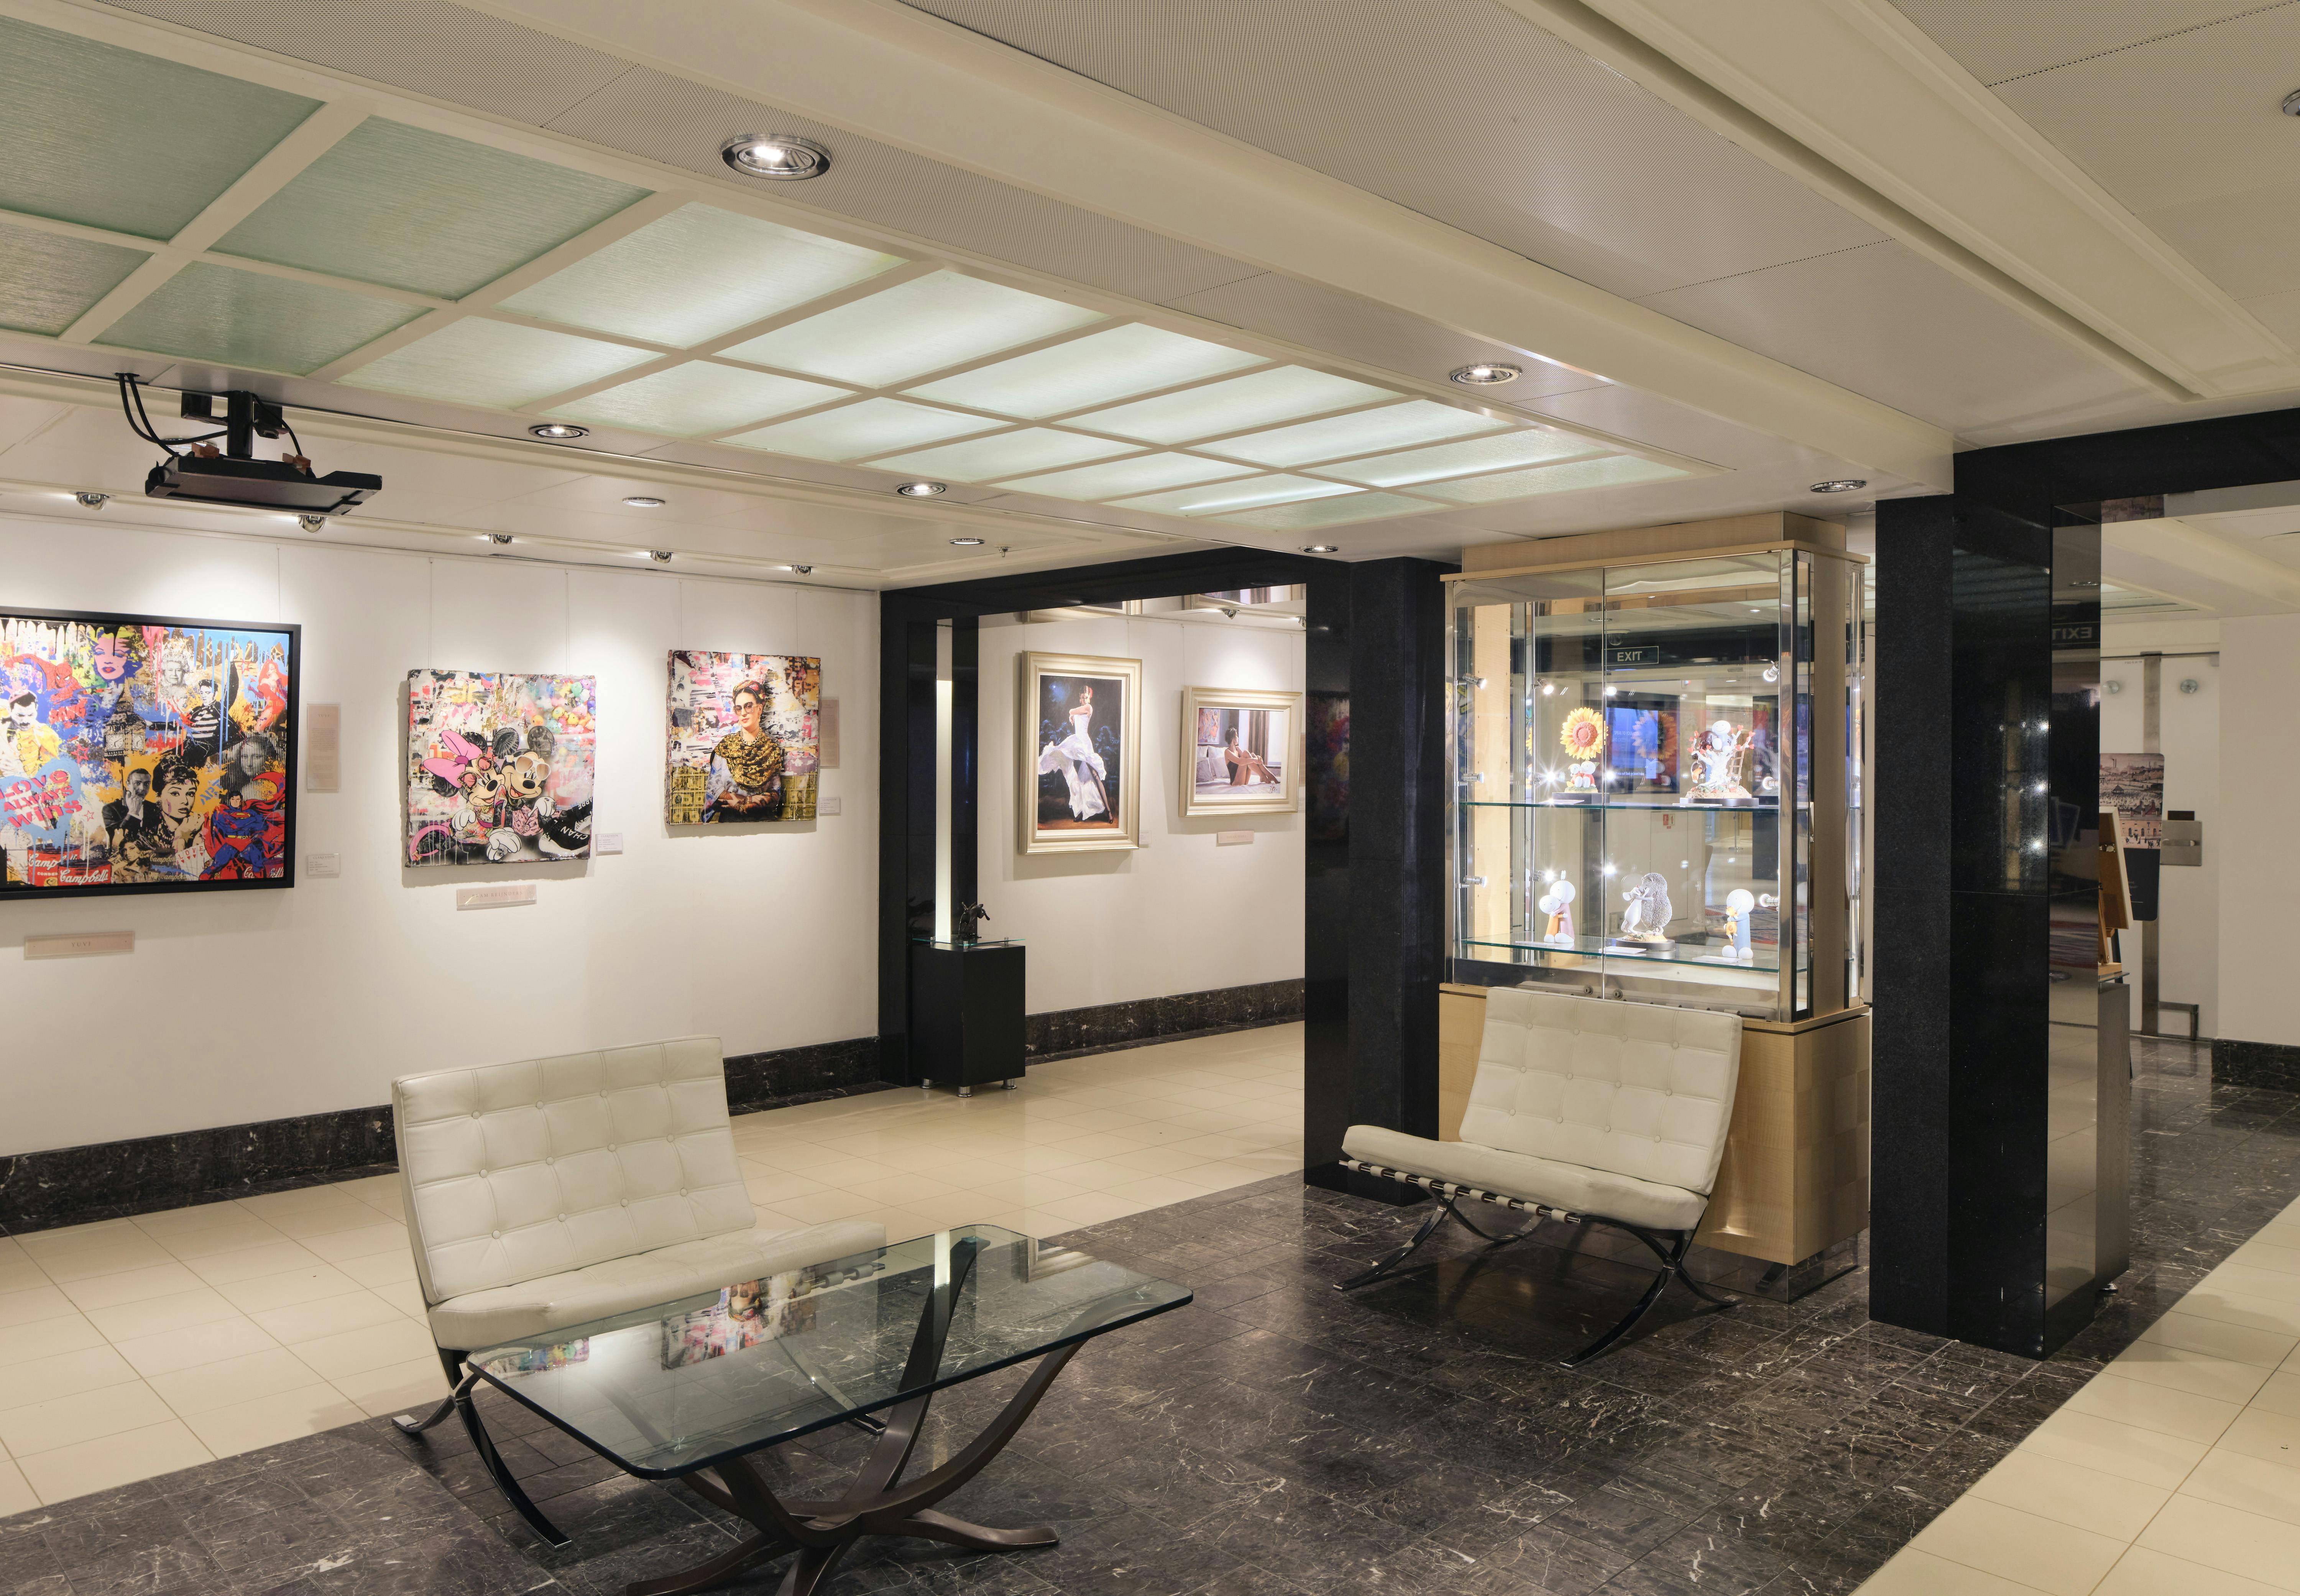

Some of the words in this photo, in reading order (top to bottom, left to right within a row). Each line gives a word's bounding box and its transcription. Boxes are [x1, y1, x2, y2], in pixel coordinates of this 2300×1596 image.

[1617, 651, 1643, 662] EXIT
[200, 779, 223, 805] ART
[178, 846, 203, 860] LOVE
